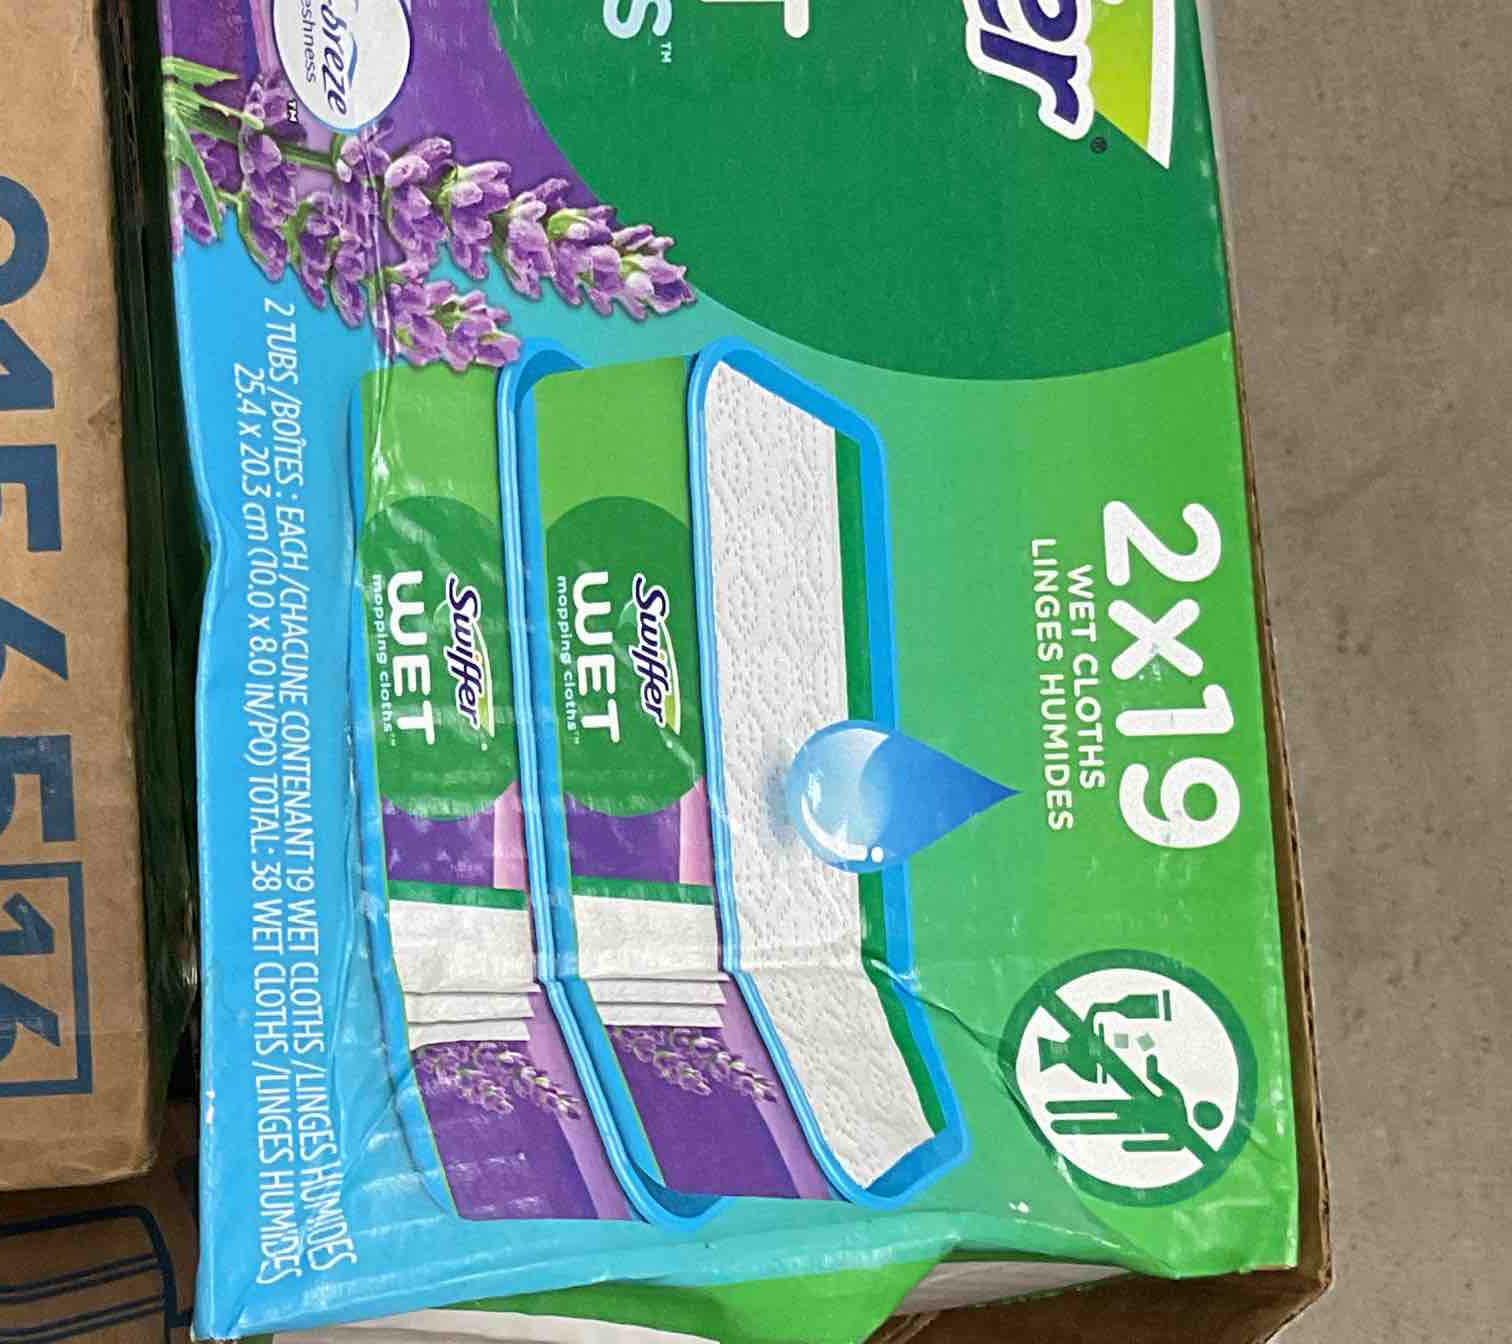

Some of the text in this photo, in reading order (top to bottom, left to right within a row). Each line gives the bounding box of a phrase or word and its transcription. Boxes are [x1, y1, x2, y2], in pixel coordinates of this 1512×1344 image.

[264, 298, 294, 315] 2
[233, 363, 266, 415] 25.4
[266, 322, 298, 384] TUBS
[240, 421, 260, 436] x
[240, 443, 270, 496] 20.3
[244, 502, 271, 541] cm
[275, 506, 308, 570] EACH
[247, 547, 277, 609] (10.0
[249, 615, 271, 628] x
[249, 636, 276, 674] 8.0
[372, 575, 389, 664] mopping
[388, 570, 435, 744] WET
[444, 575, 483, 728] Swiffer
[557, 576, 573, 664] mopping
[573, 572, 620, 743] WET
[629, 575, 670, 726] Swiffer
[1031, 538, 1074, 830] LINGES HUMIDES
[1067, 564, 1105, 788] WET CLOTHS
[1103, 501, 1241, 848] 2x19
[244, 682, 279, 766] IN/PO)
[249, 774, 281, 854] TOTAL:
[281, 710, 314, 860] CONTENANT
[251, 861, 282, 892] 38
[285, 865, 314, 892] 19
[252, 899, 283, 955] WET
[287, 899, 319, 955] WET
[253, 962, 288, 1055] CLOTHS
[289, 962, 324, 1053] CLOTHS
[256, 1170, 302, 1284] HUMIDES
[299, 1160, 357, 1271] HUMIDES
